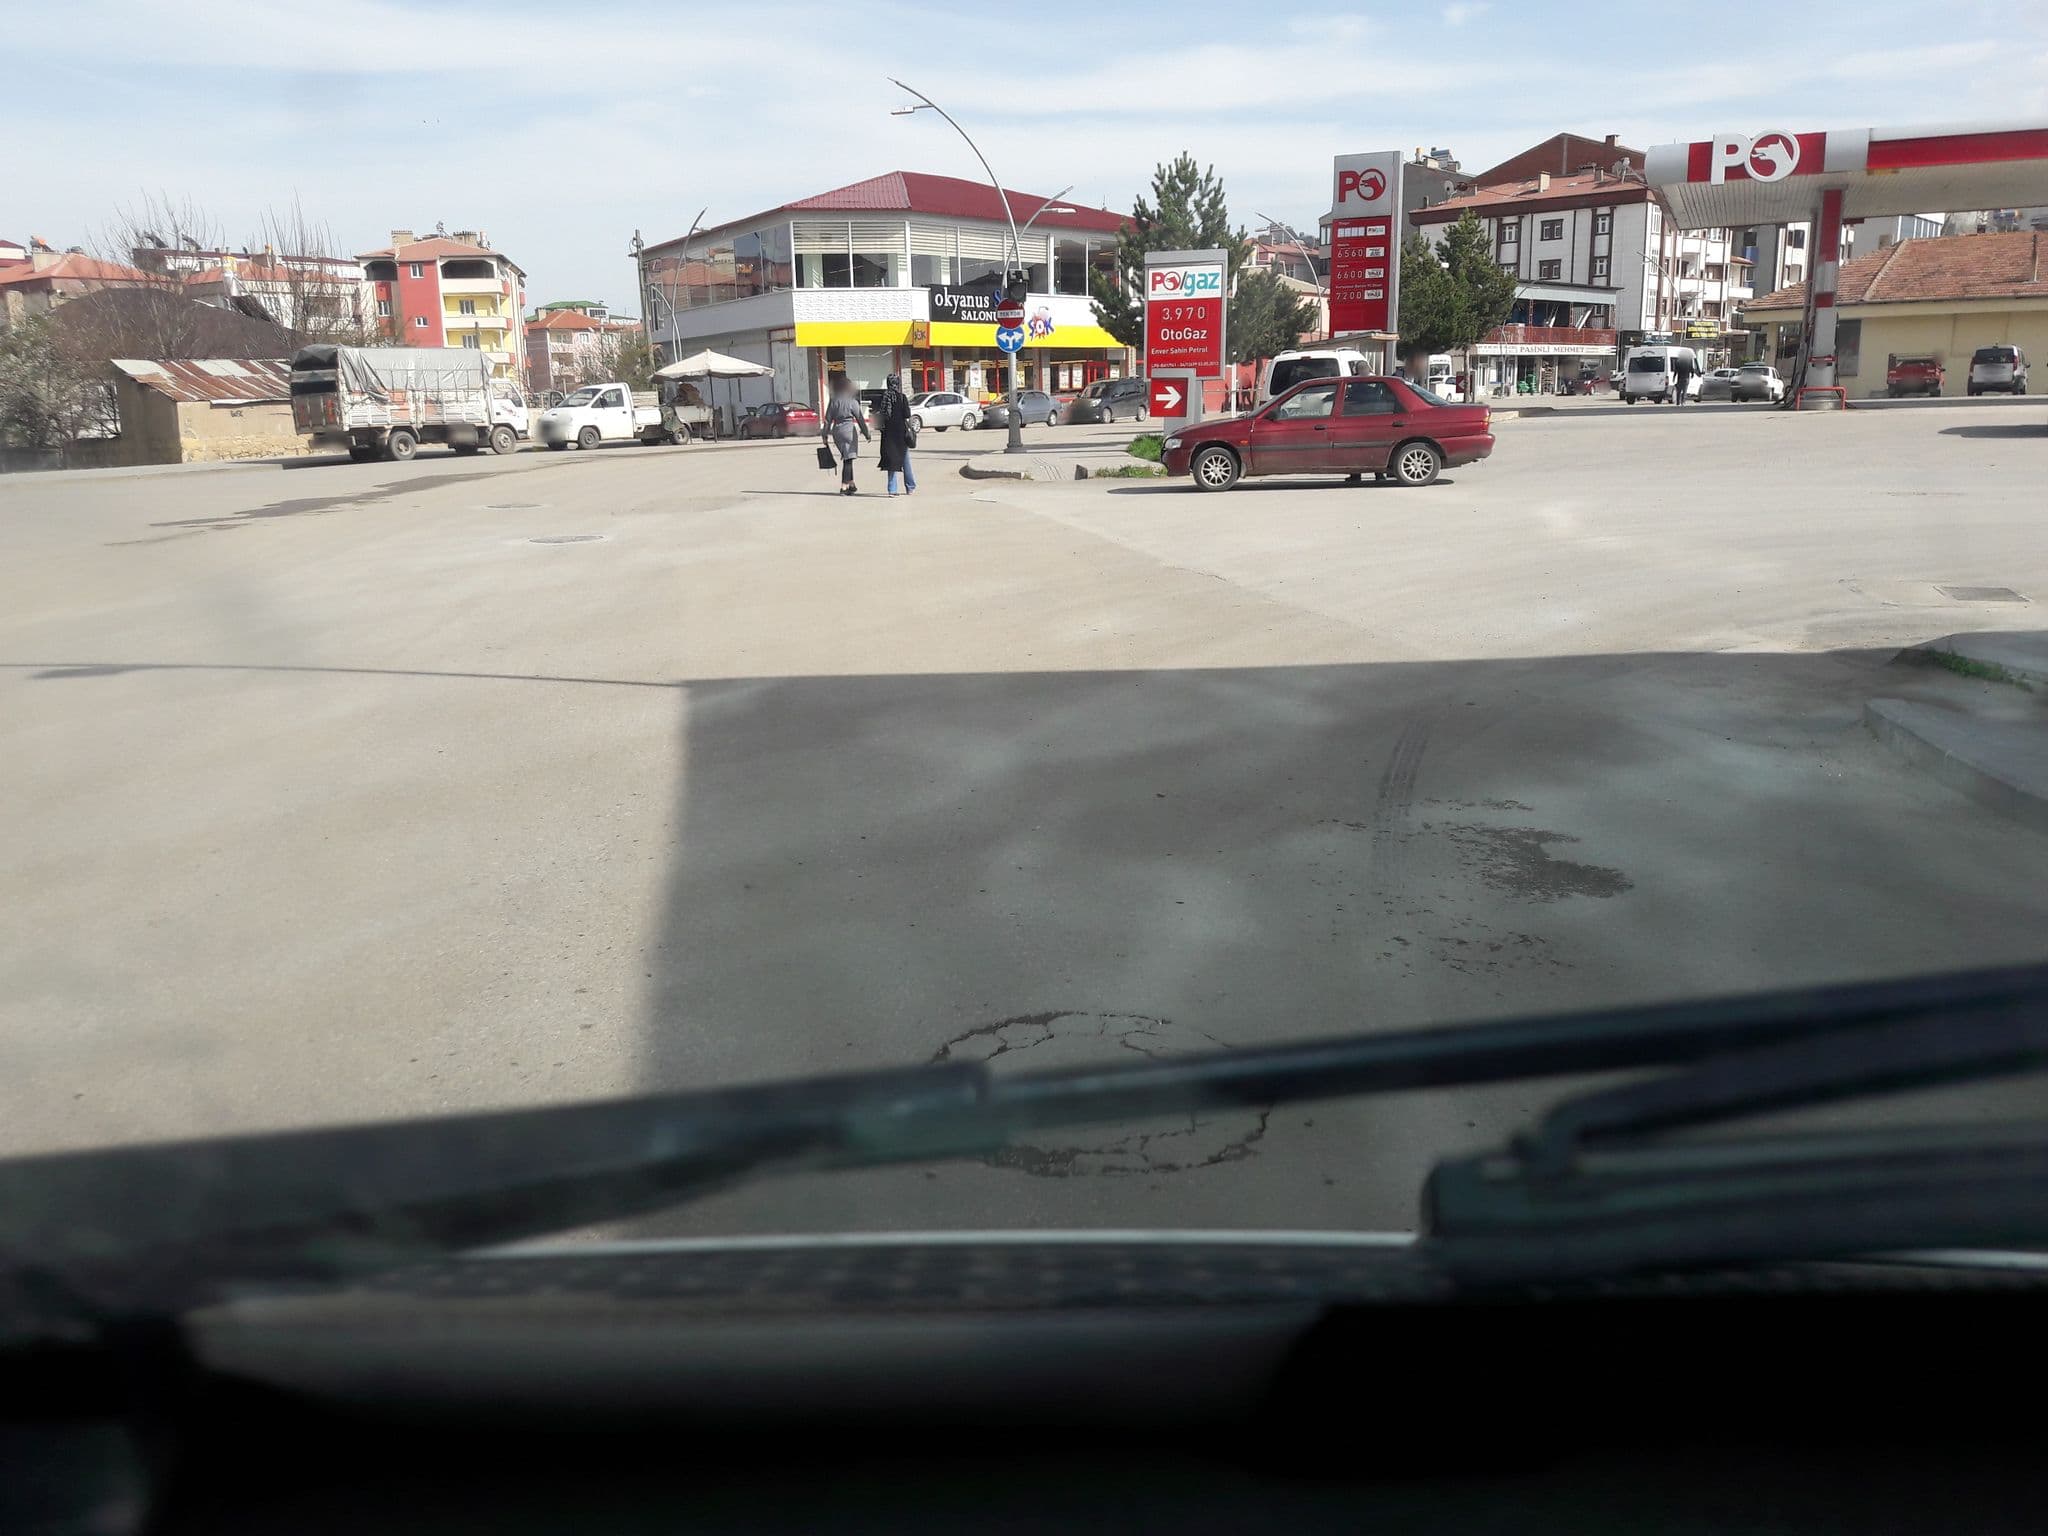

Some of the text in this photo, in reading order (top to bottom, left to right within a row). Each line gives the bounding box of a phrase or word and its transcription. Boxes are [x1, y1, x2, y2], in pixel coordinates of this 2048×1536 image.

[1338, 168, 1386, 203] PO
[934, 286, 990, 315] okyanus
[1160, 327, 1208, 341] OtoGaz
